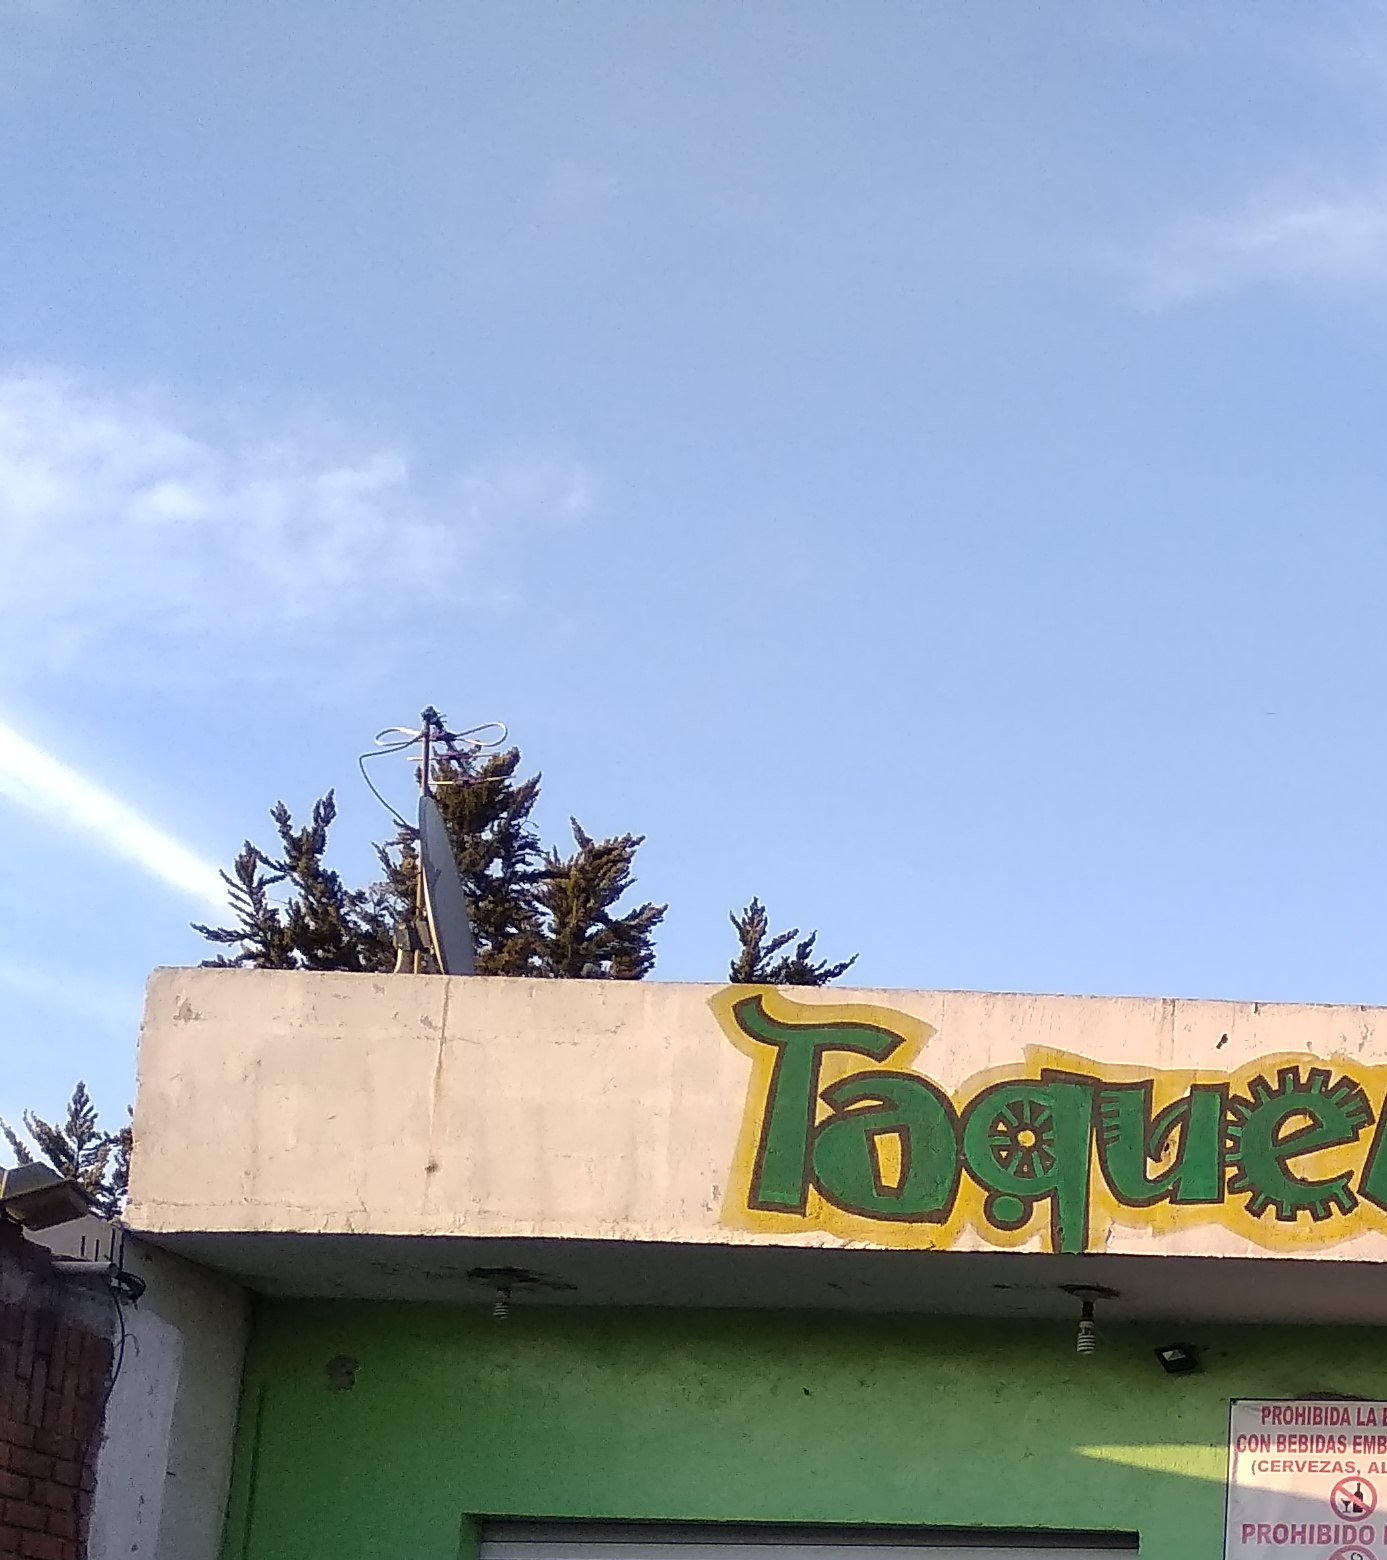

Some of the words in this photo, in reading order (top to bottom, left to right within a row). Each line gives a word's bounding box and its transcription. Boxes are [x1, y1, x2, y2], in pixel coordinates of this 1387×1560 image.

[1261, 1405, 1352, 1427] PROHIBIDA
[1356, 1407, 1377, 1428] LA
[1236, 1433, 1274, 1454] CON
[1276, 1434, 1348, 1455] BEBIDAS
[1251, 1460, 1362, 1476] (CERVEZAS,
[1241, 1523, 1375, 1546] PROHIBIDO
